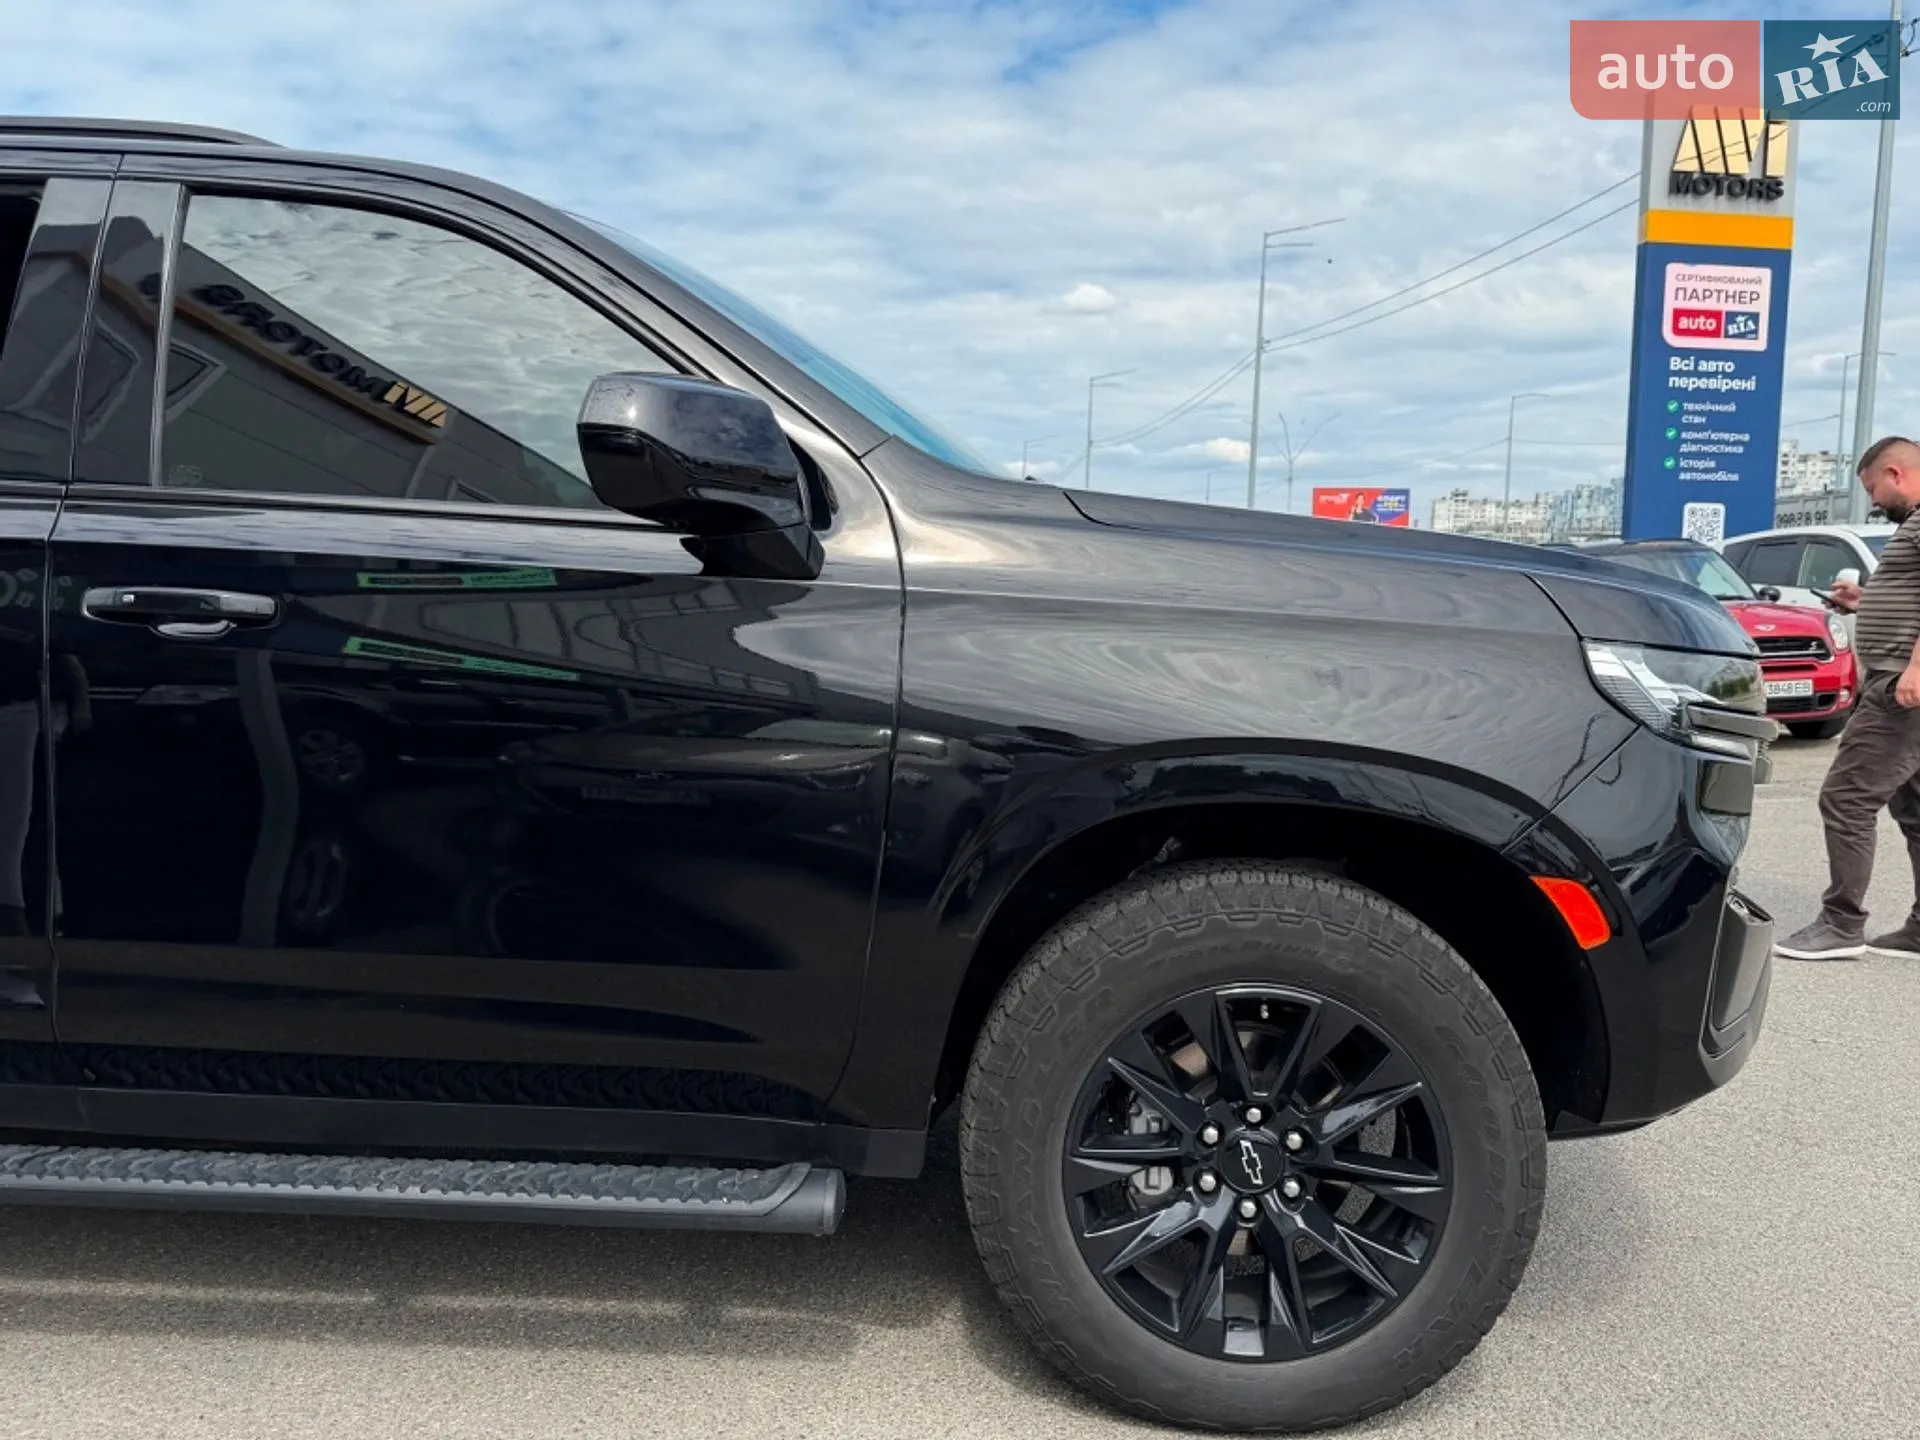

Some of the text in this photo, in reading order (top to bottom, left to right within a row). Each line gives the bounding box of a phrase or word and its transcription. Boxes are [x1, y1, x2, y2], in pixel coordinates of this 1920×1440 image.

[1668, 174, 1784, 201] MOTORS
[1674, 287, 1761, 305] ПАРТНЕР
[1678, 315, 1717, 331] auto
[1670, 356, 1736, 373] Всі авто
[1668, 375, 1757, 393] перевірені
[1681, 415, 1707, 424] стан
